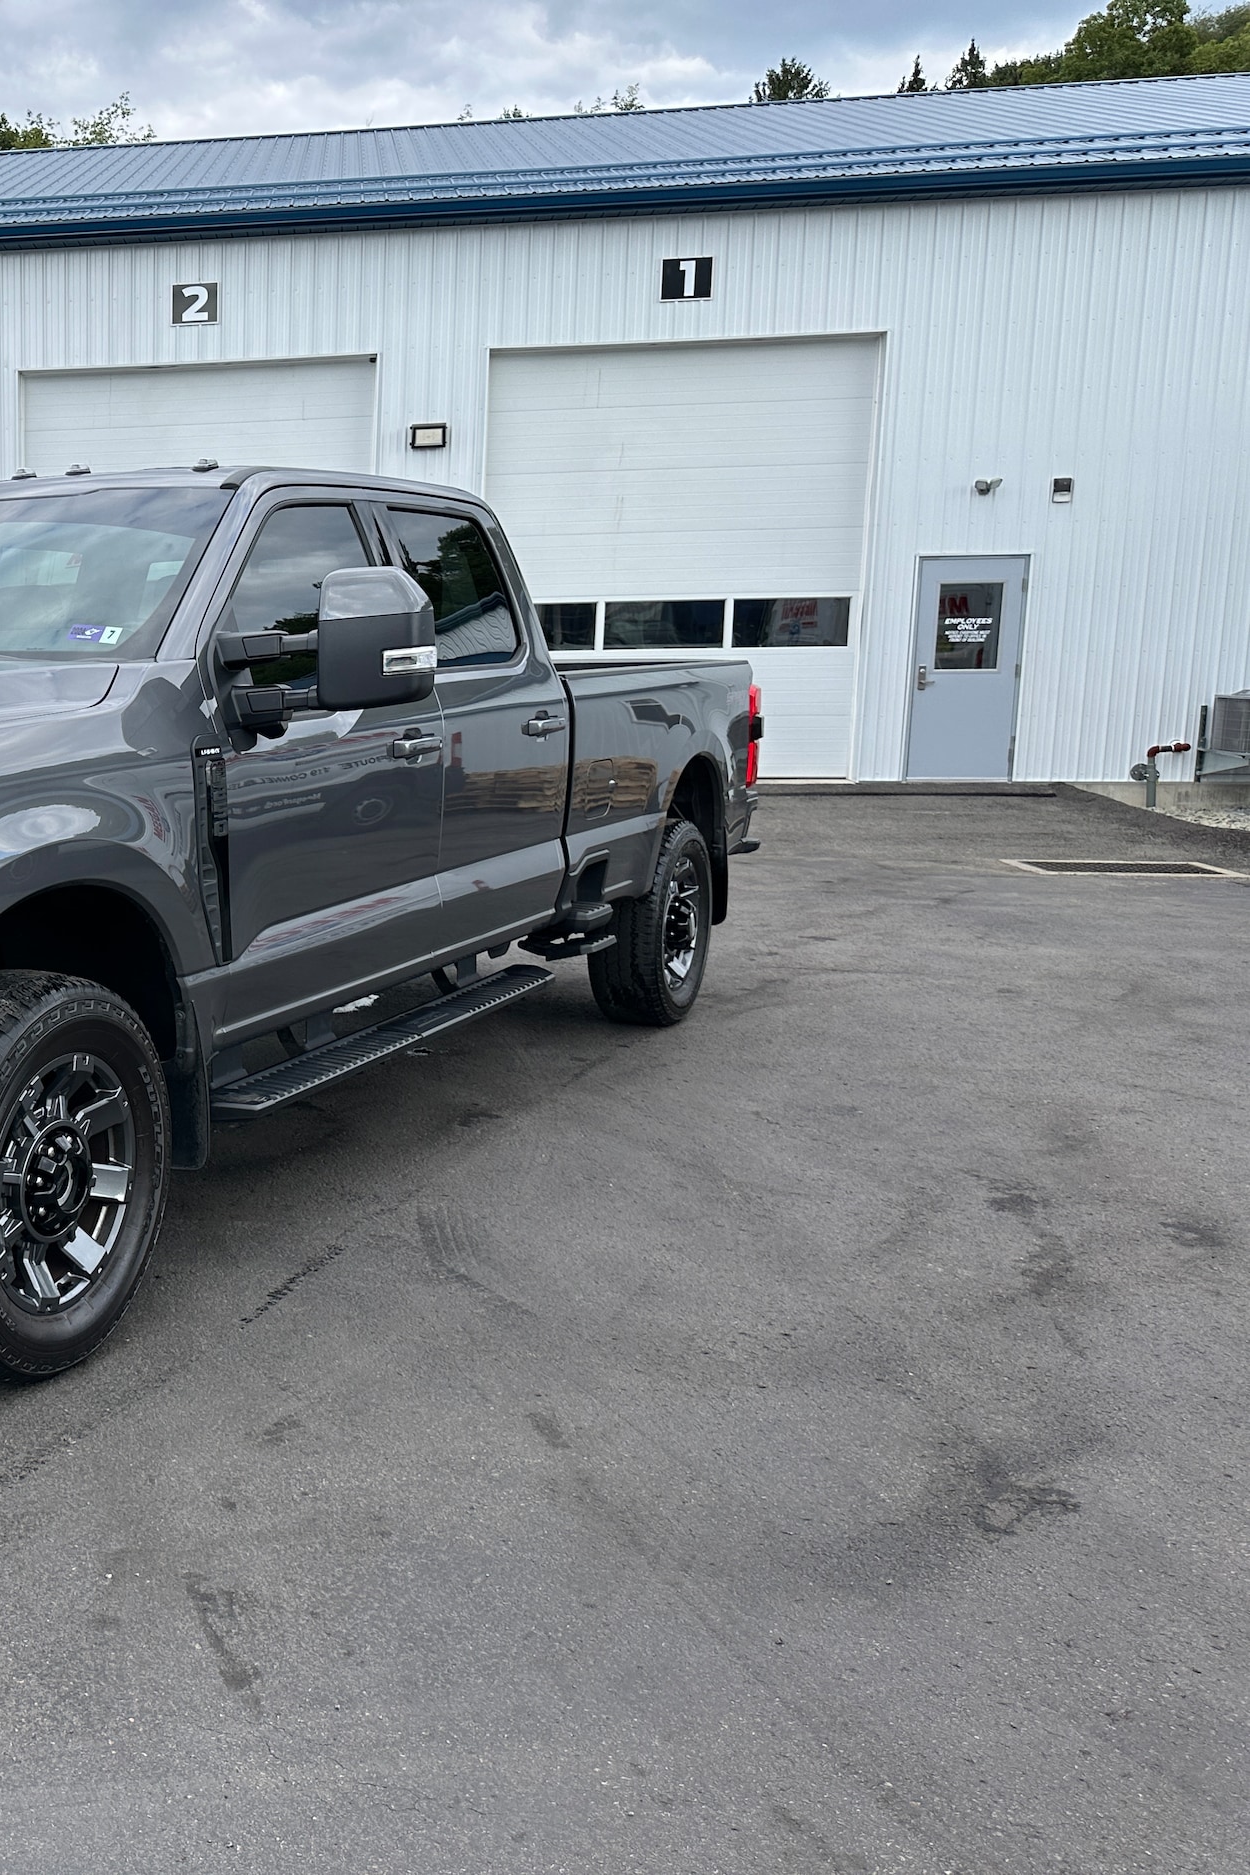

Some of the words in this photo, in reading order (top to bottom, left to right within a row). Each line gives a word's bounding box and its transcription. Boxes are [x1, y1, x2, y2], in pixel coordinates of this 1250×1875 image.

[679, 260, 696, 297] 1
[182, 286, 209, 322] 2
[944, 617, 993, 625] EMPLOYEES
